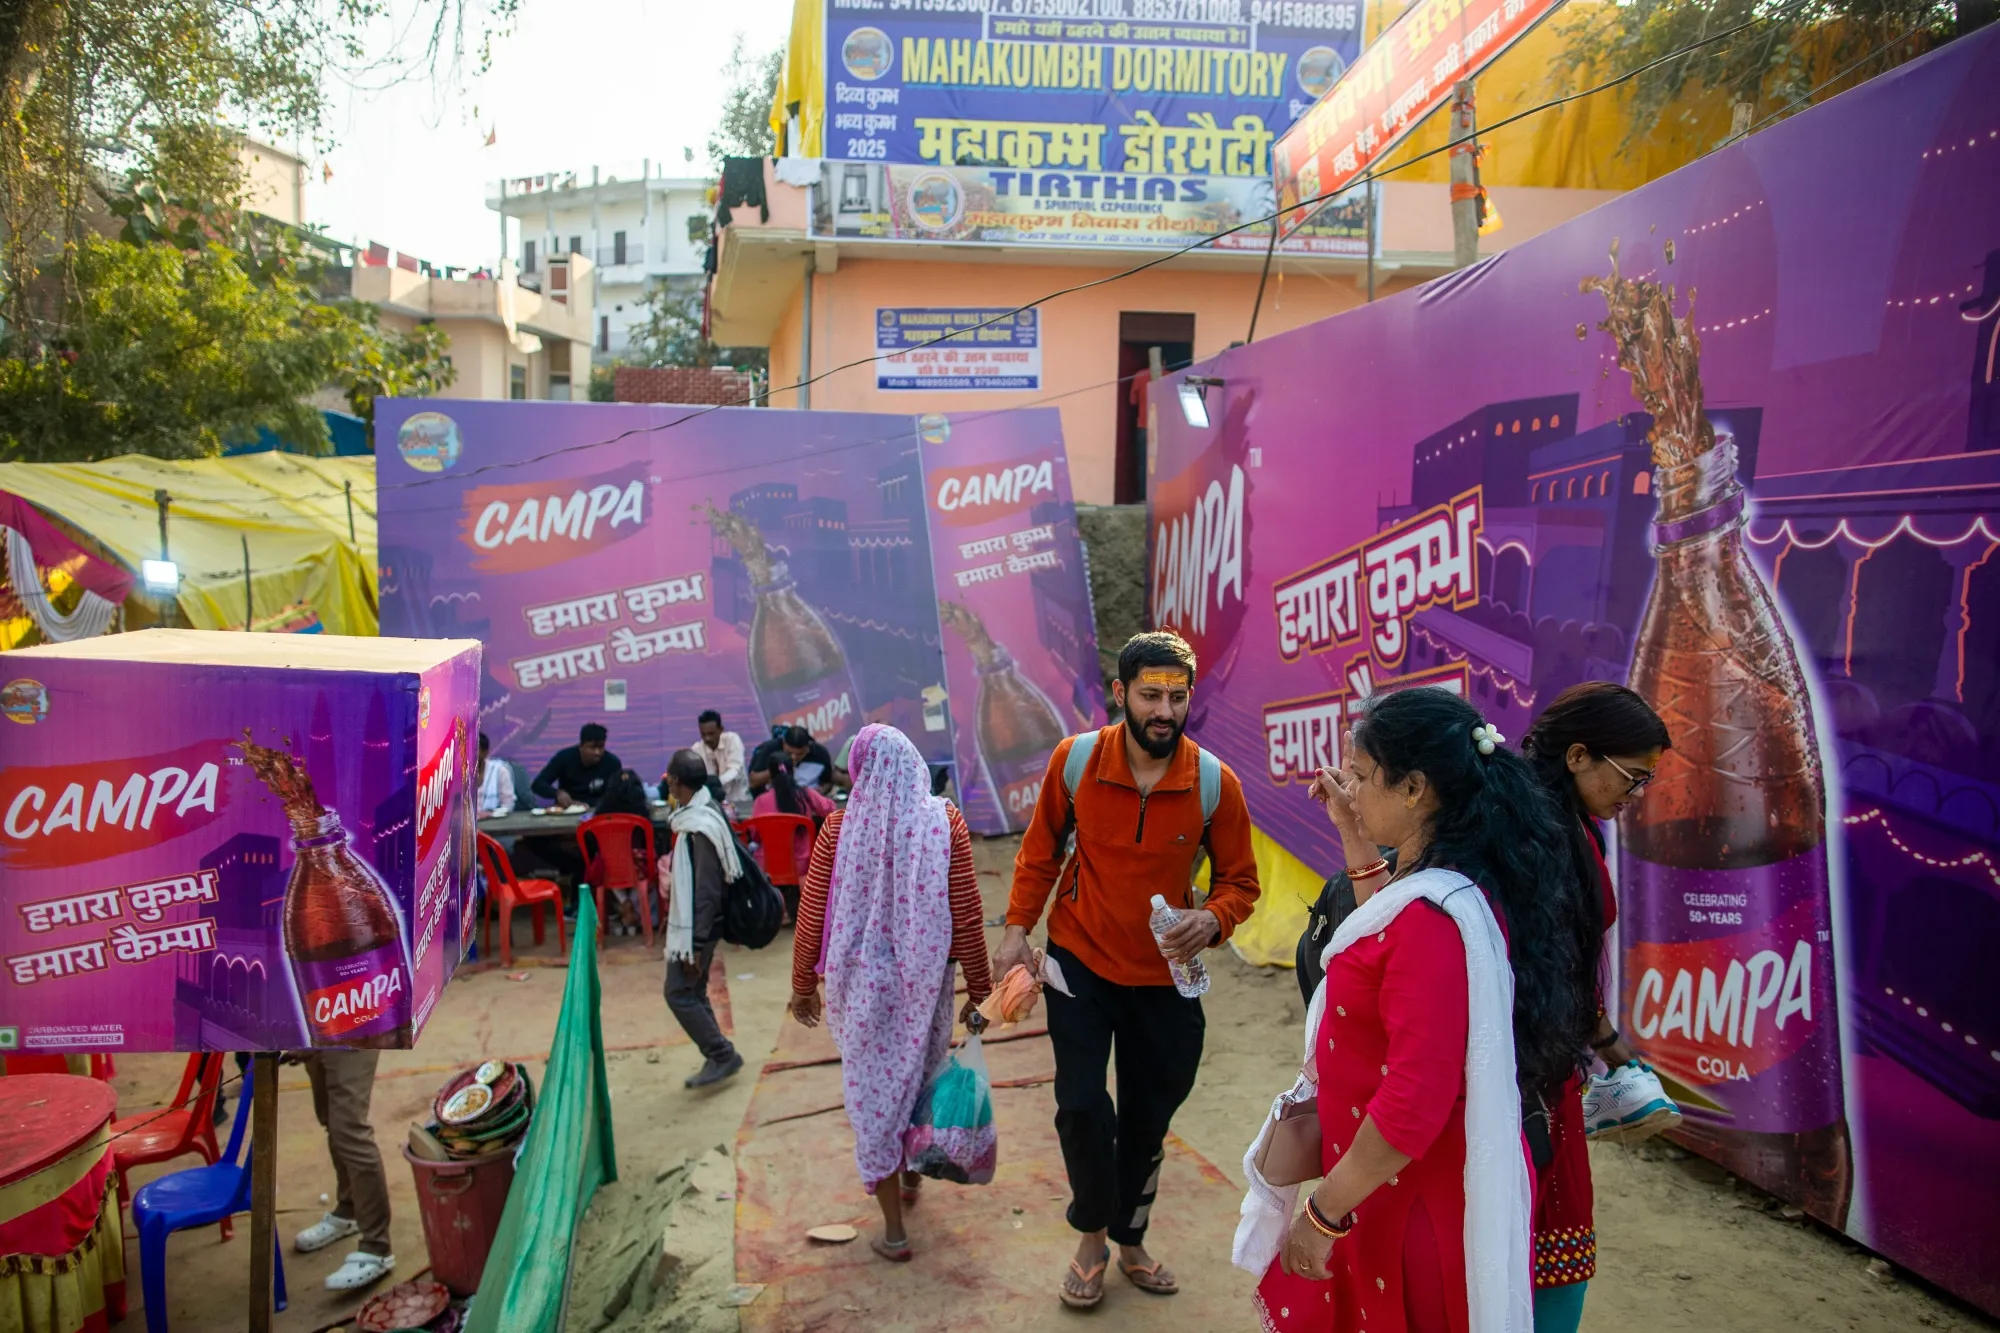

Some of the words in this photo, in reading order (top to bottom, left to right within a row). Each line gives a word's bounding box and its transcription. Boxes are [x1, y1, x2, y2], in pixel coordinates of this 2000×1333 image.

[902, 38, 1102, 89] MAHAKUMBH
[1112, 46, 1288, 97] DORMITORY
[835, 81, 866, 104] दिव्य
[866, 87, 900, 110] कुम्भ
[835, 113, 863, 131] भव्य
[863, 114, 898, 137] कुम्भ
[847, 138, 887, 158] 2025
[989, 171, 1209, 201] TIRTHAS
[938, 461, 1054, 511] CAMPA
[473, 480, 645, 550] CAMPA
[958, 536, 1008, 560] हमारा
[1010, 524, 1054, 552] कुम्भ
[1153, 464, 1244, 636] CAMPA
[954, 563, 1004, 587] हमारा
[1006, 550, 1057, 573] कैम्पा
[1275, 556, 1361, 656] हमारा
[1366, 502, 1477, 656] कुम्भ
[527, 592, 619, 636] हमारा
[626, 573, 706, 622] कुम्भ
[514, 642, 607, 689] हमारा
[612, 620, 706, 666] कैम्पा
[782, 692, 851, 736] MPA
[1264, 702, 1343, 777] हमारा
[3, 762, 220, 841] CAMPA
[228, 757, 244, 767] TM
[418, 738, 455, 836] CAMPA
[23, 888, 120, 932] हमारा
[129, 870, 217, 920] कुम्भ
[1684, 892, 1747, 907] CELEBRATING
[1689, 910, 1708, 922] 50+
[1709, 911, 1743, 925] YEARS
[8, 943, 106, 984] हमारा
[113, 920, 216, 963] कैम्पा
[336, 960, 369, 972] CELEBRATING
[350, 966, 368, 975] YEARS
[315, 967, 402, 1023] CAMPA
[1632, 939, 1813, 1048] CAMPA
[1817, 930, 1830, 942] TM
[28, 1025, 89, 1034] CARBONATED
[91, 1024, 125, 1032] WATER.
[354, 1013, 380, 1024] COLA
[27, 1036, 73, 1046] CONTAINS
[1697, 1056, 1751, 1082] COLA
